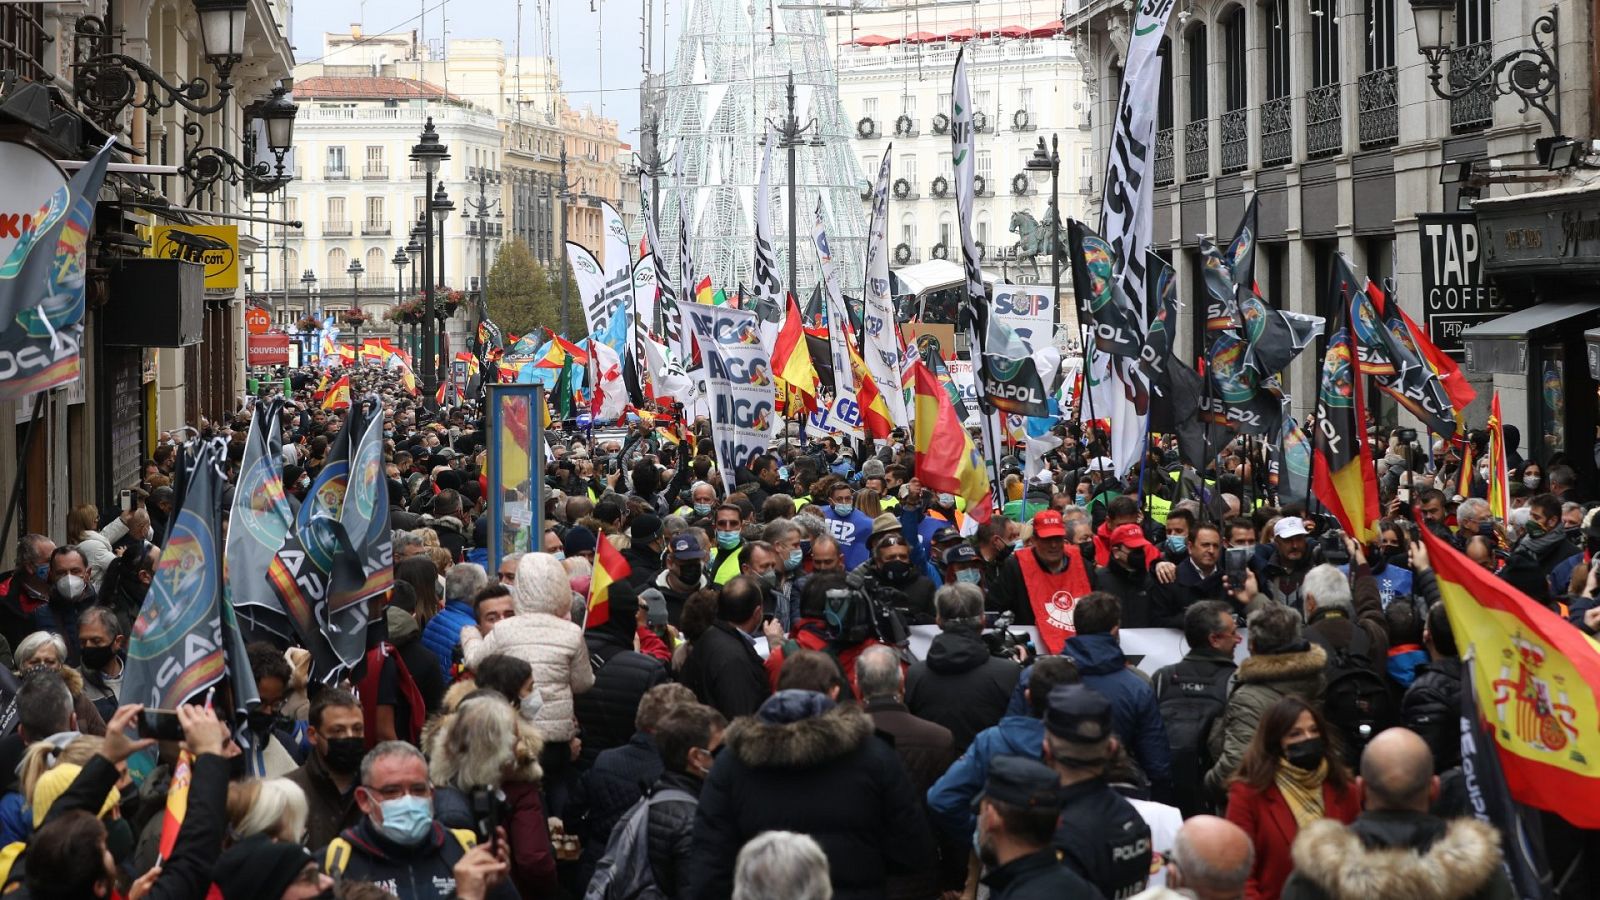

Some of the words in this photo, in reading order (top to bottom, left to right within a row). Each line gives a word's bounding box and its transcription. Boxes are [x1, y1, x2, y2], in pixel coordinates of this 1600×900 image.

[1425, 223, 1482, 286] TAP
[636, 272, 655, 283] CSIF
[1429, 287, 1500, 310] COFFE
[248, 313, 267, 326] ria
[249, 346, 290, 355] SOUVENIRS
[708, 350, 771, 386] AGC
[716, 394, 772, 431] AGC
